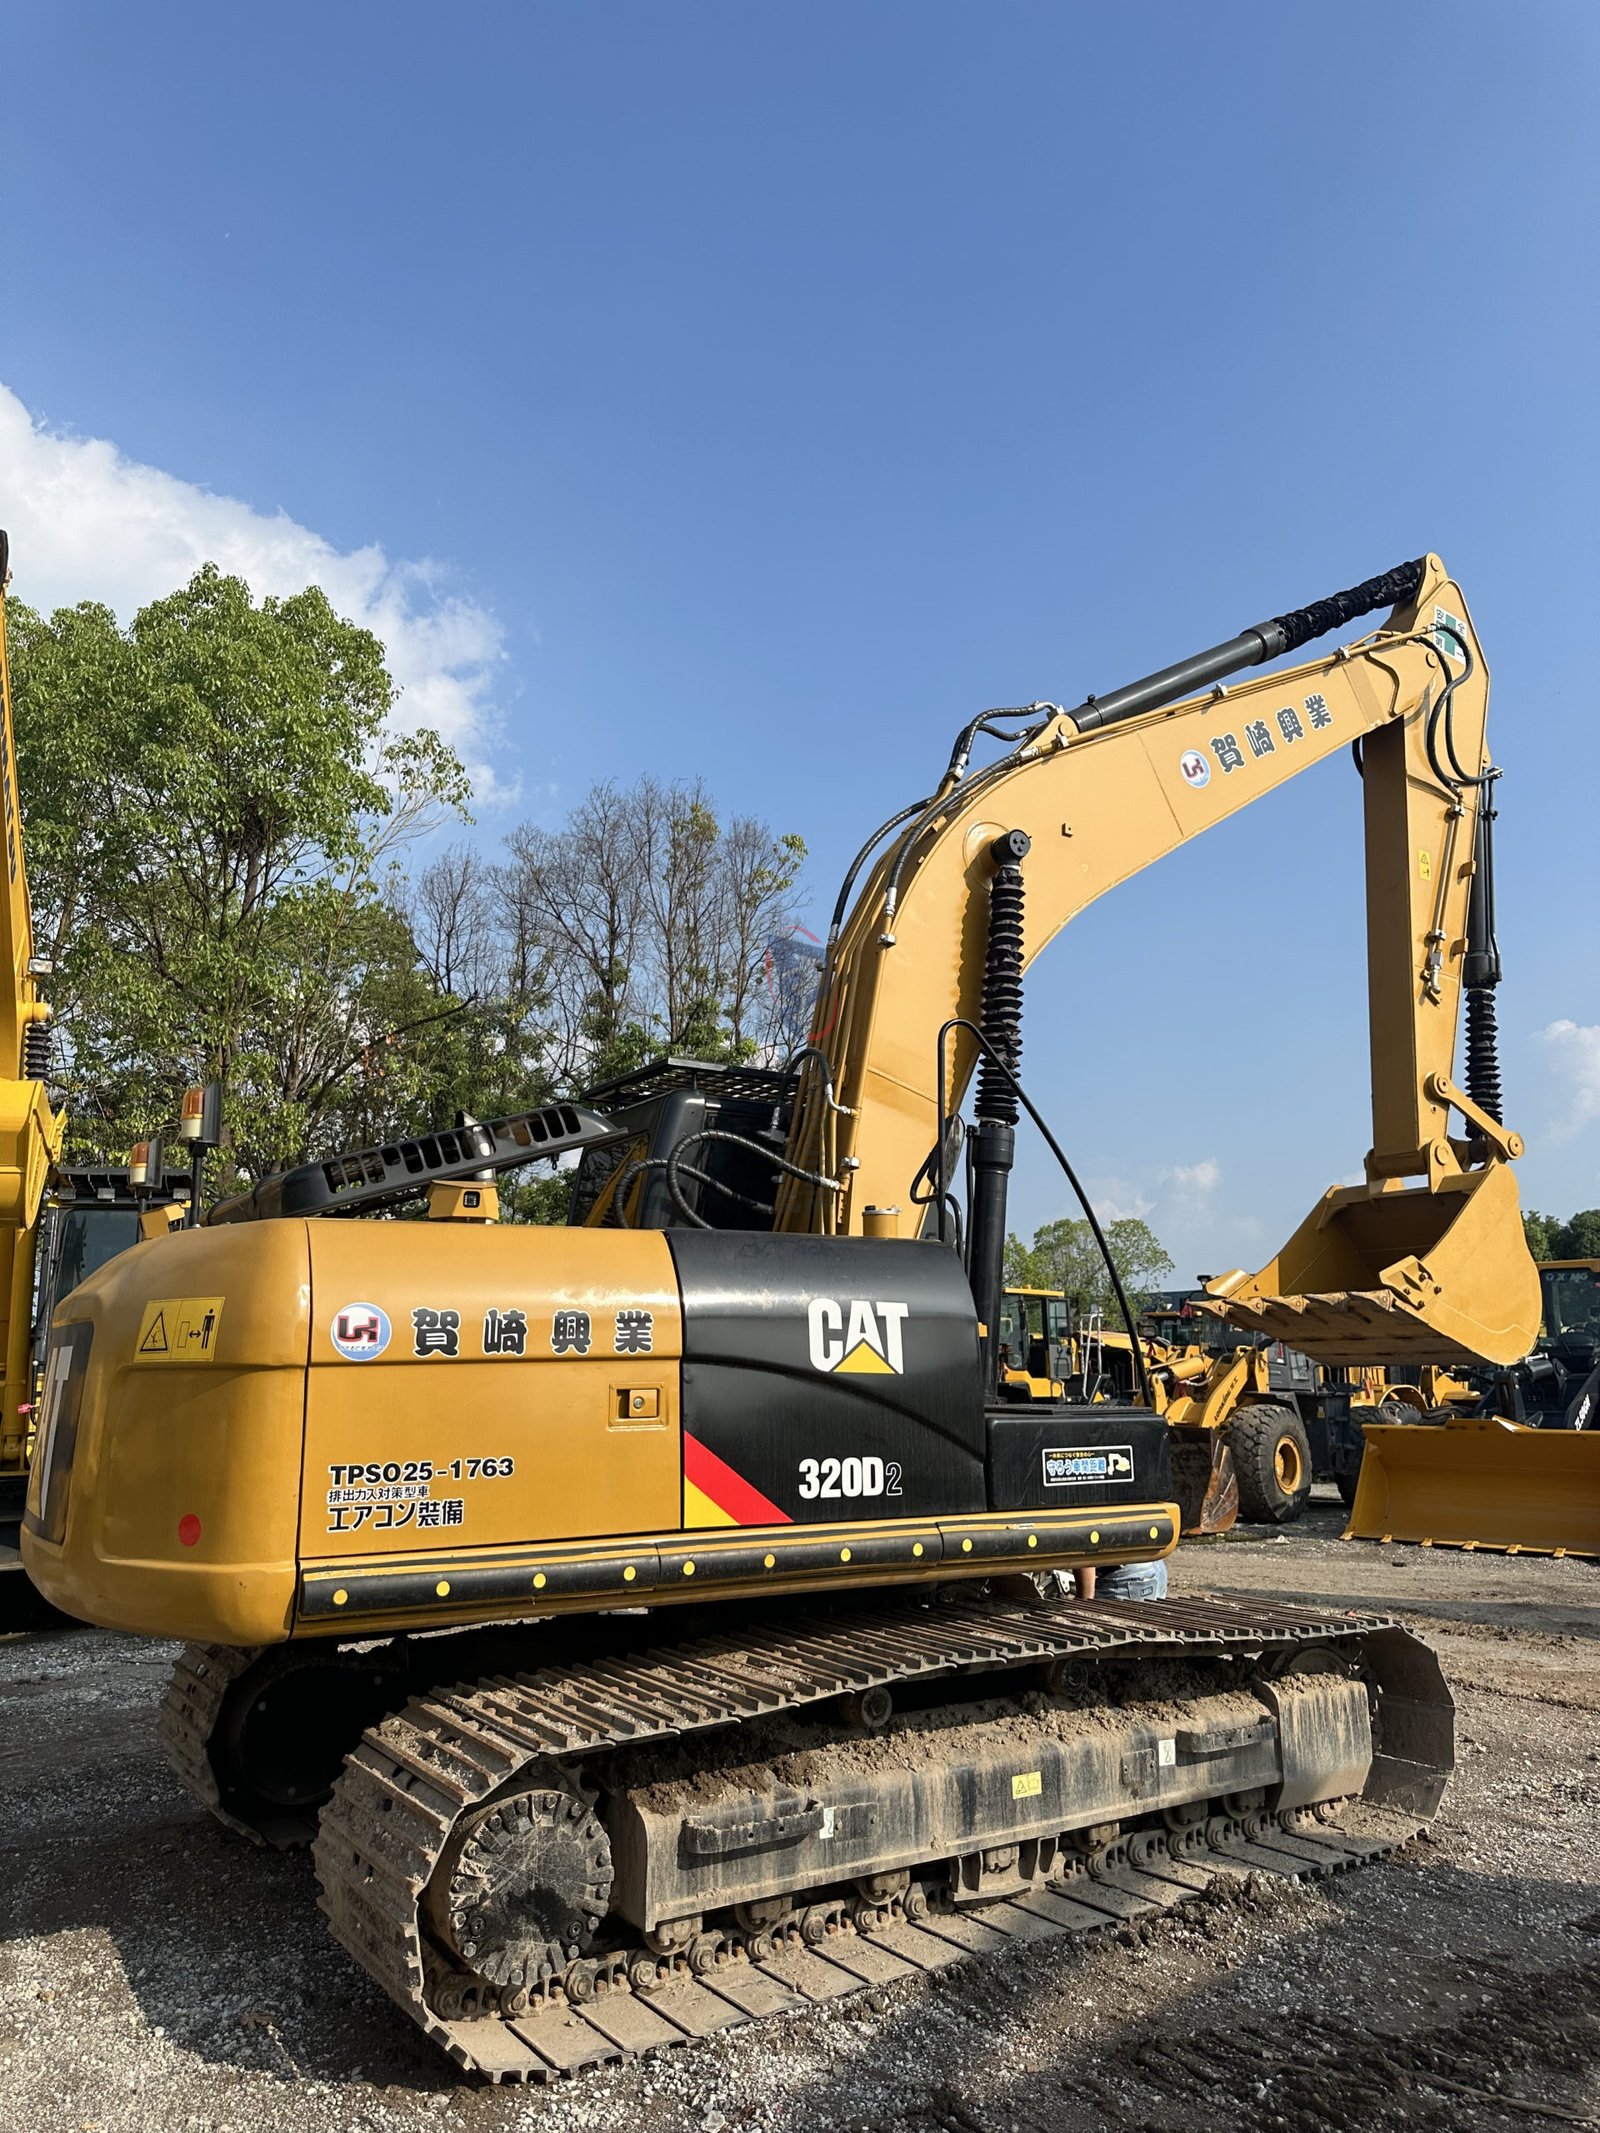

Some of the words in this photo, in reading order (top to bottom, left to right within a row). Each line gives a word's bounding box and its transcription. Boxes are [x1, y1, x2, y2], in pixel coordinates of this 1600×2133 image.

[808, 1298, 909, 1374] CAT
[799, 1456, 902, 1499] 320D2
[327, 1499, 464, 1532] エアコン装備
